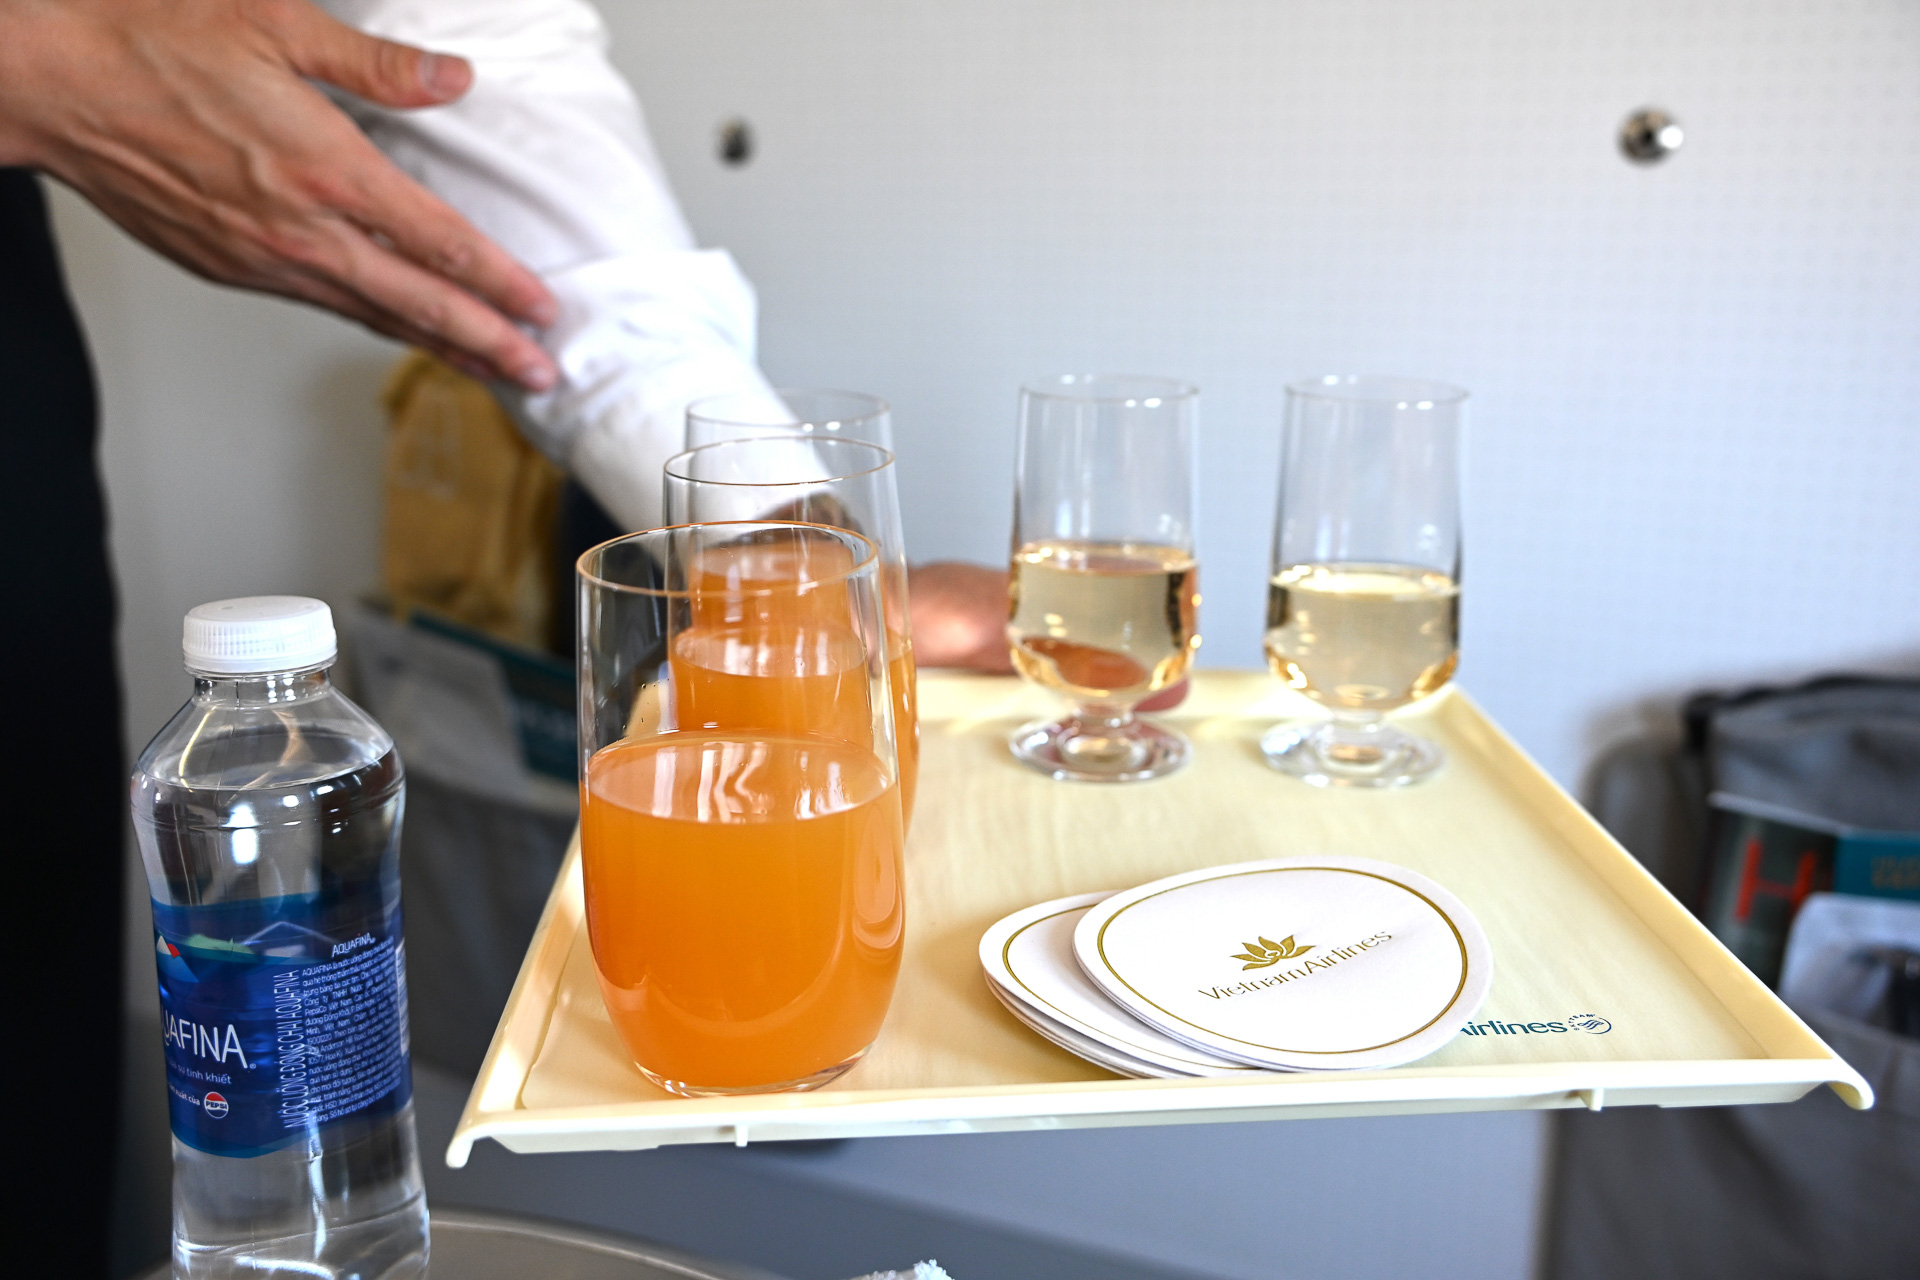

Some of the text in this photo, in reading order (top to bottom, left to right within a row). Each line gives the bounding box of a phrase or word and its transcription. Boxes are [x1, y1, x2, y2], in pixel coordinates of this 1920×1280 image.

[273, 970, 302, 1018] AQUAFINA
[162, 1009, 248, 1068] UAFINA
[277, 1020, 304, 1042] CHAI
[206, 1101, 227, 1110] PEPSI
